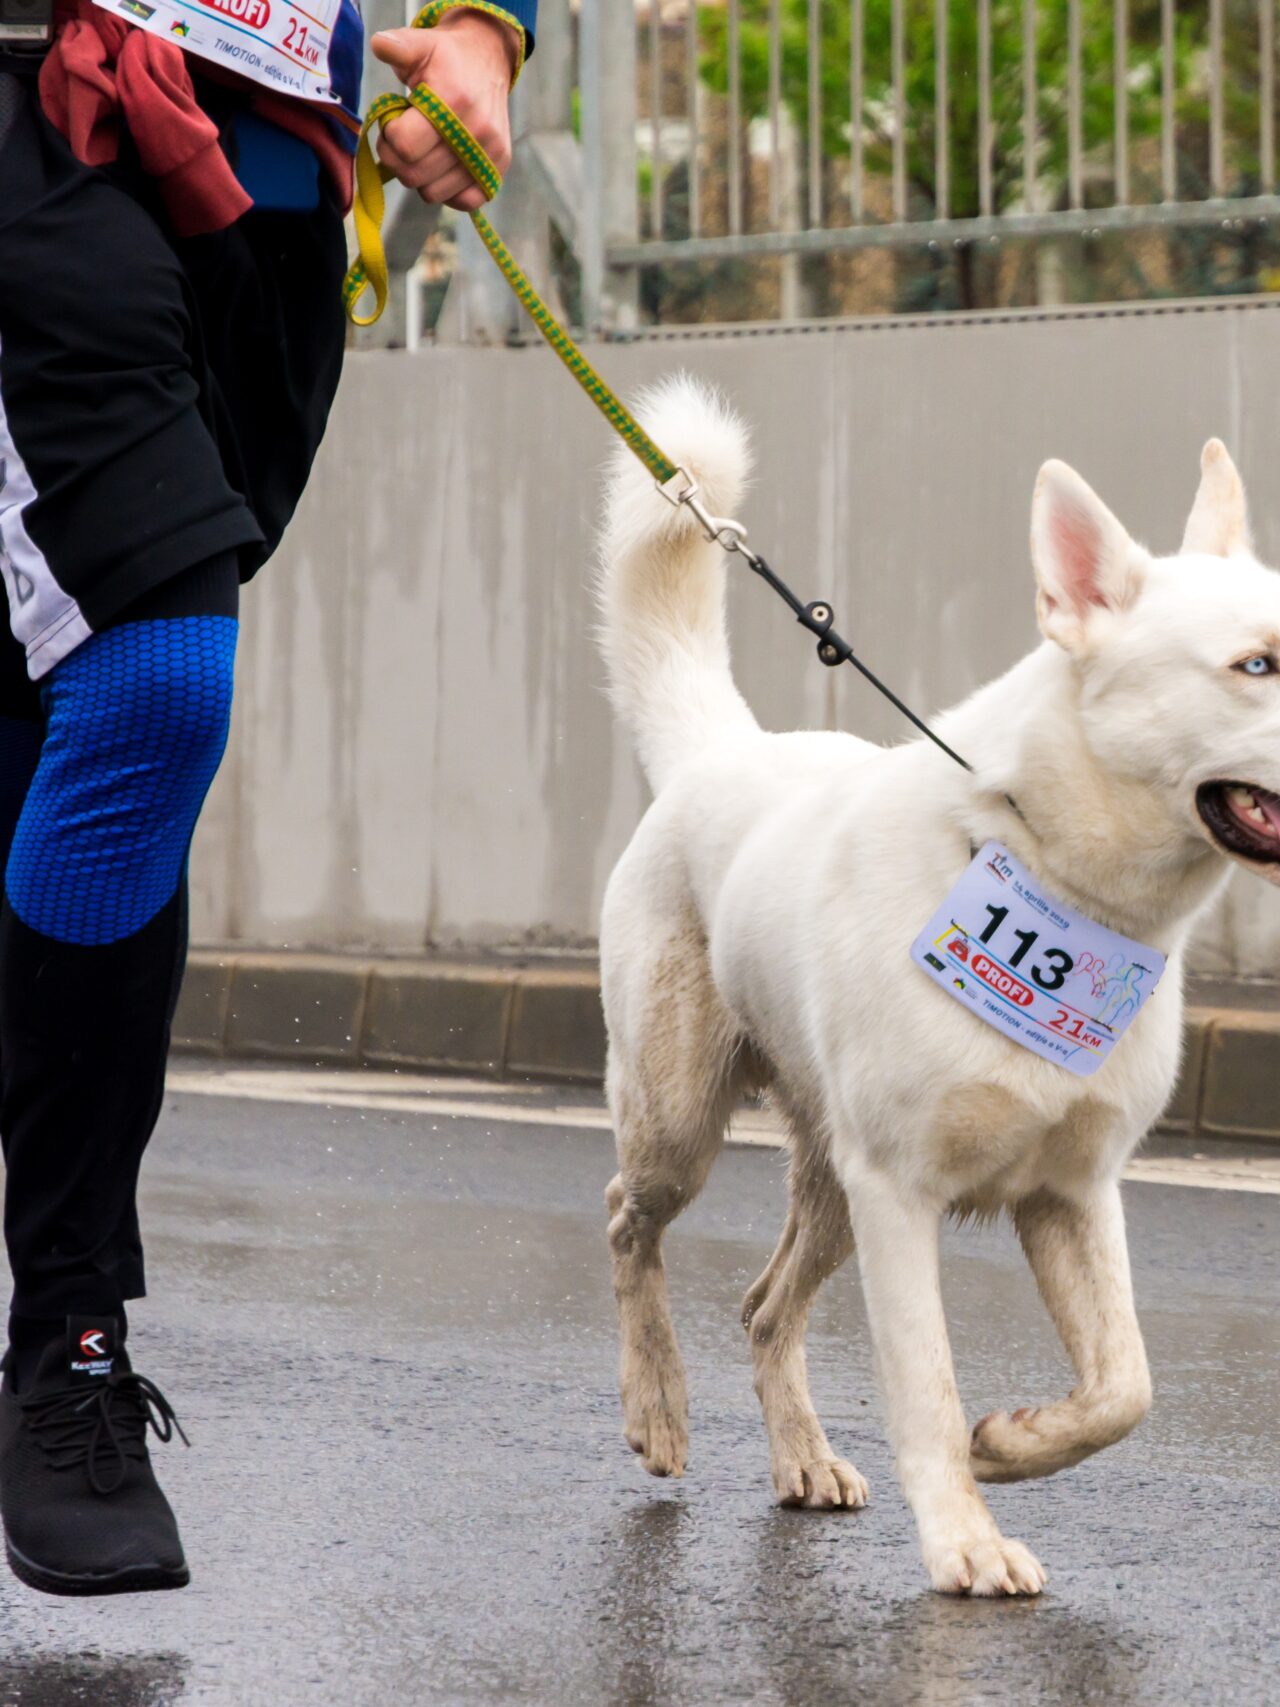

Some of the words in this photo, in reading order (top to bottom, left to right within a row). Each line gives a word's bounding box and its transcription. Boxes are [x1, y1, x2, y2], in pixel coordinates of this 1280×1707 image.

[214, 38, 260, 68] TIMOTION
[282, 17, 308, 57] 21
[304, 45, 320, 66] KM
[979, 903, 1074, 990] 113
[975, 958, 1029, 1004] PROFI
[983, 1000, 1022, 1028] TIMOTION
[1049, 1010, 1085, 1039] 21
[1082, 1033, 1102, 1048] KM
